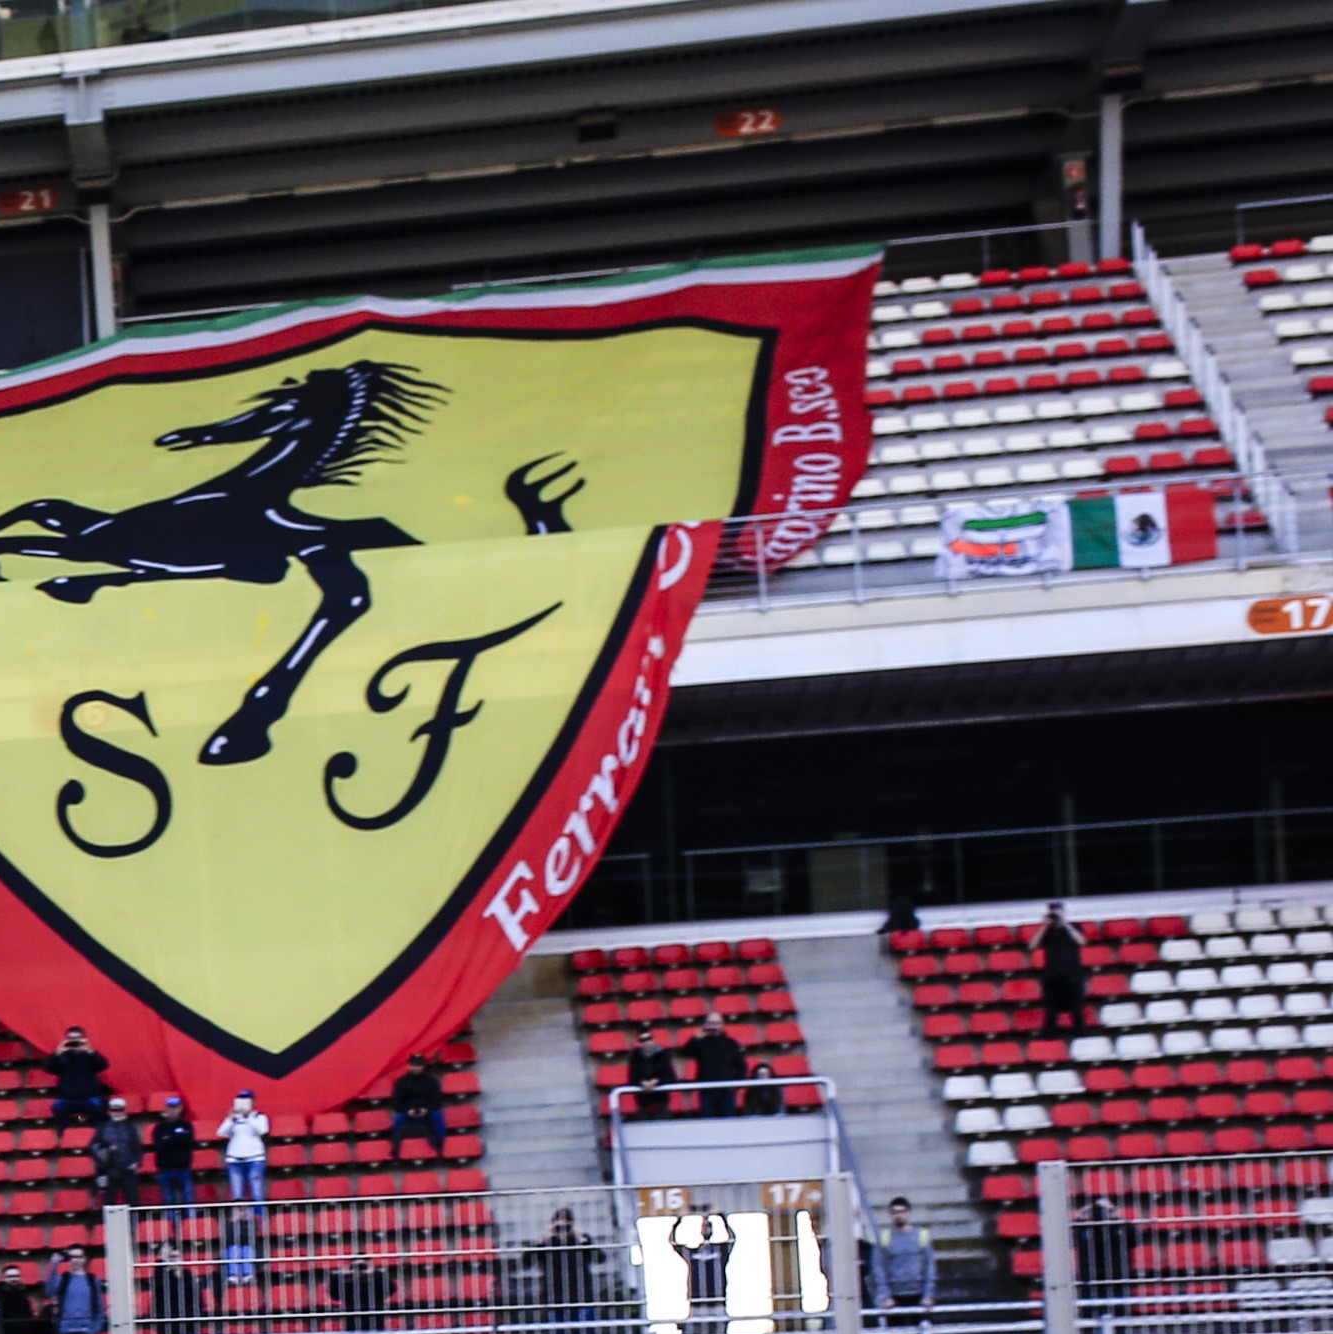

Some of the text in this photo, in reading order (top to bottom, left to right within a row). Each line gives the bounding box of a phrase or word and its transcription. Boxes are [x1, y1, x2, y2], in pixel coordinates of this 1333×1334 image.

[740, 110, 774, 133] 22
[20, 189, 51, 210] 21
[1280, 596, 1333, 630] 17
[54, 600, 565, 858] S F
